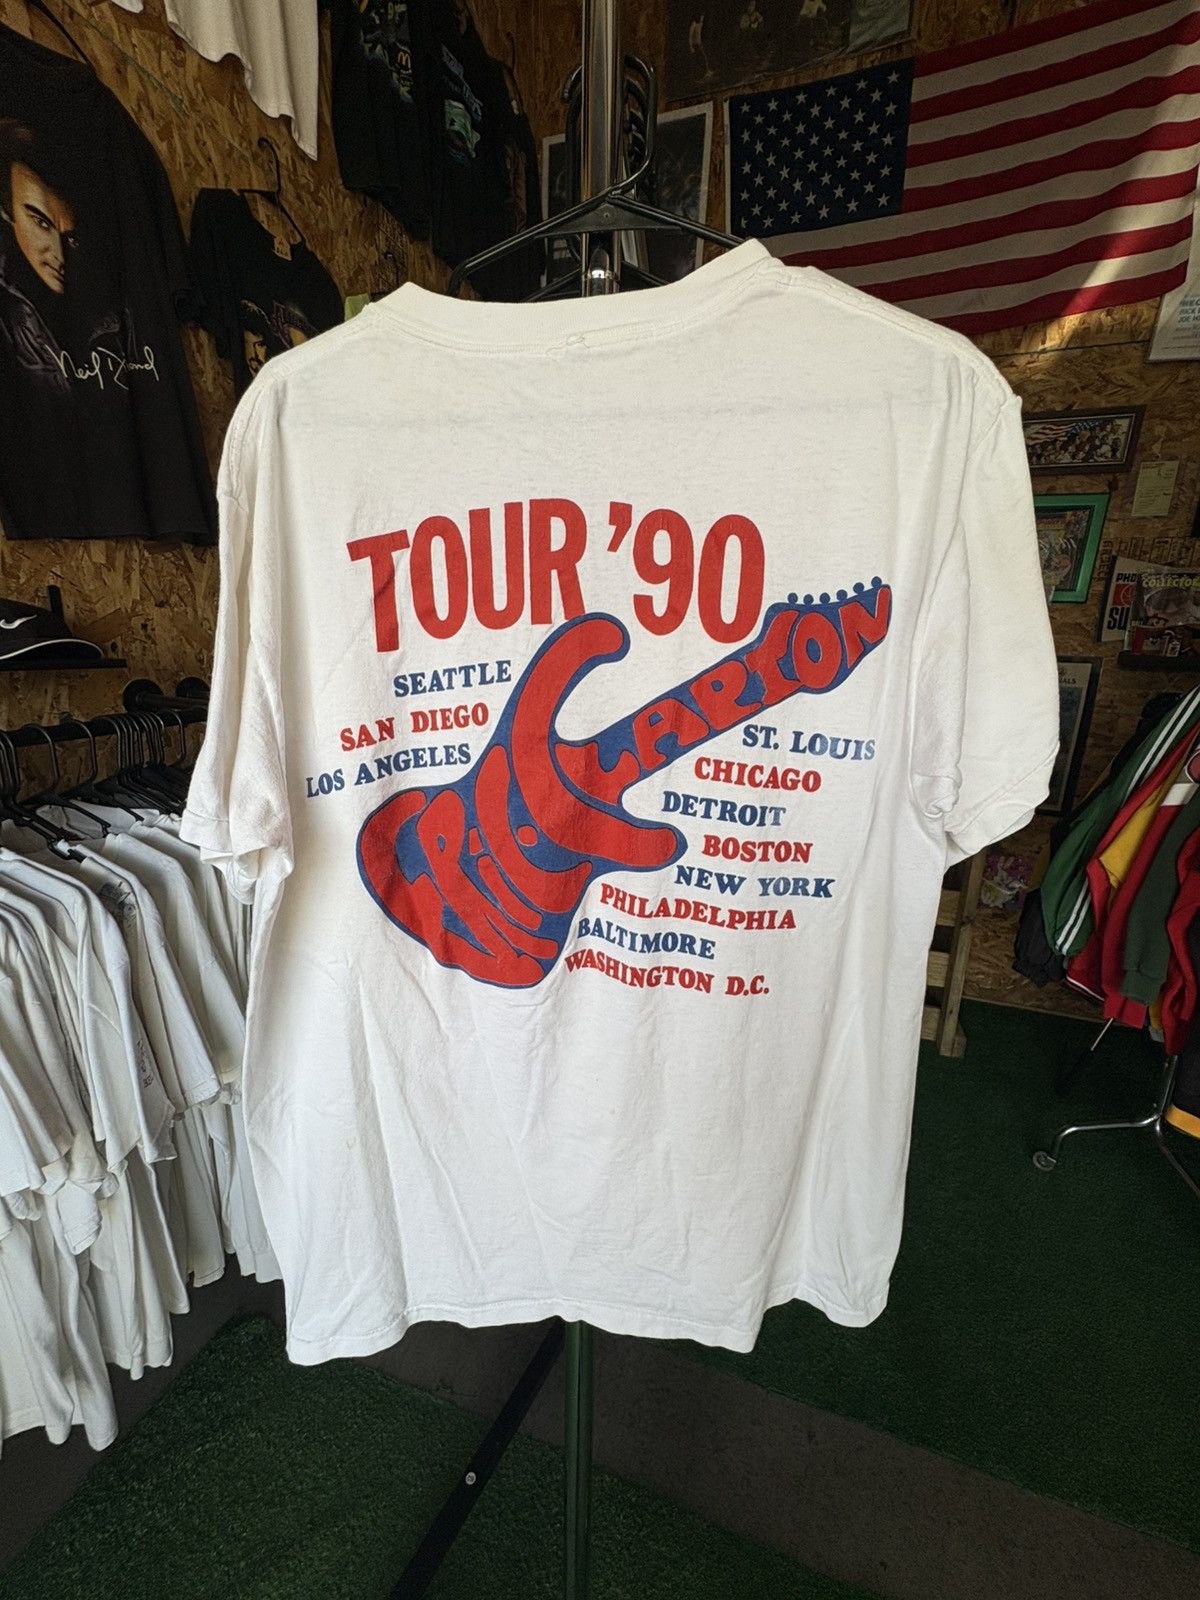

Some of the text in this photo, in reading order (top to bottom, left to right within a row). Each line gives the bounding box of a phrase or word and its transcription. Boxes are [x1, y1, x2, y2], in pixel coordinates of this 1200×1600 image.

[45, 344, 104, 390] Neil
[346, 498, 765, 653] TOUR '90
[393, 660, 512, 697] SEATTLE
[340, 702, 489, 751] SAN DIEGO
[742, 724, 876, 760] ST. LOUIS
[306, 743, 471, 798] LOS ANGELES
[694, 756, 822, 792] CHICAGO
[662, 790, 786, 826] DETROIT
[702, 834, 813, 863] BOSTON
[675, 864, 836, 898] NEW YORK
[600, 883, 796, 930] PHILADELPHIA
[577, 917, 716, 960] BALTIMORE
[565, 948, 770, 996] WASHINGTON D.C.
